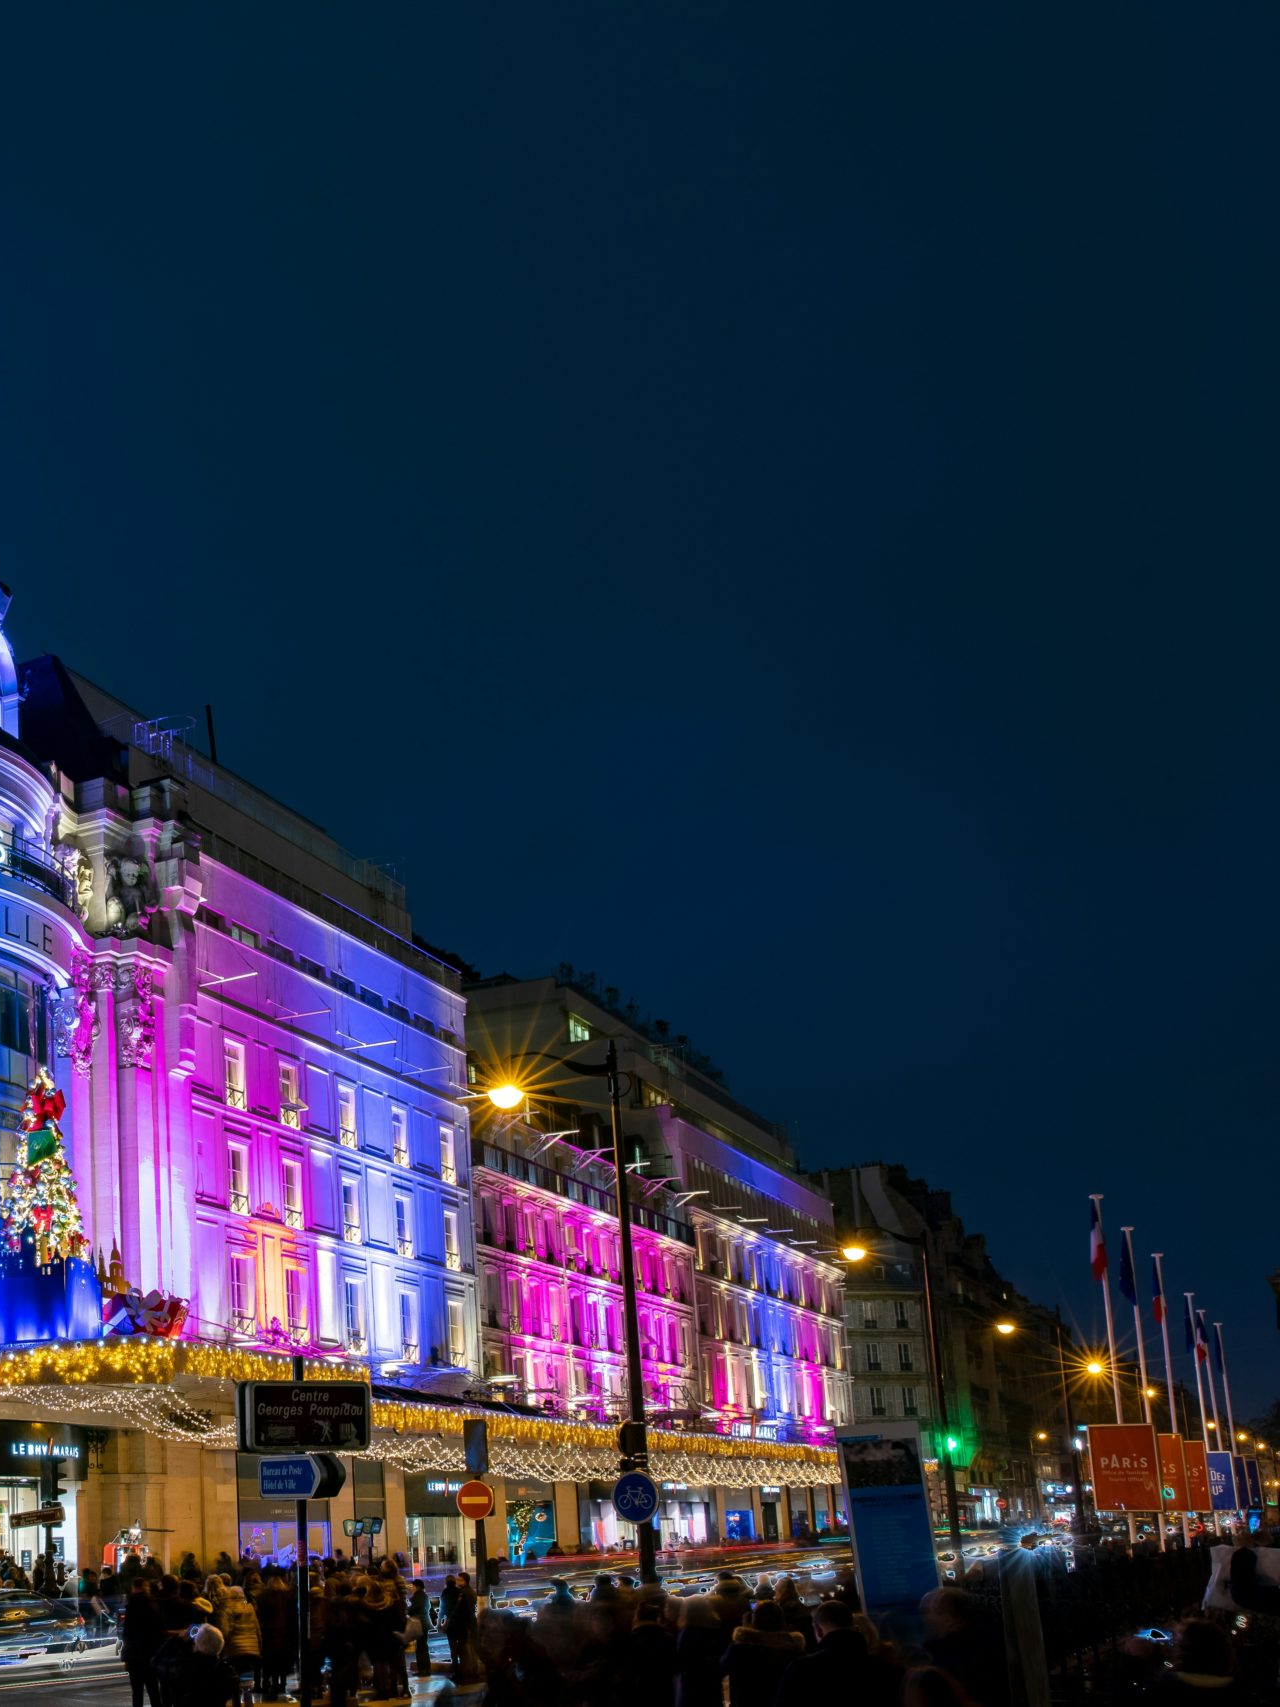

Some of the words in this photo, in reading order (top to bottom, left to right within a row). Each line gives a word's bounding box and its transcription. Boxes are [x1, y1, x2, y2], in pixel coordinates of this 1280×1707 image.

[291, 1388, 330, 1402] Centre
[257, 1403, 303, 1419] Georges
[309, 1403, 363, 1419] Pompidou
[12, 1443, 25, 1455] LE
[28, 1444, 48, 1456] BHV
[52, 1446, 79, 1458] MARAIS
[262, 1467, 280, 1476] Bureau
[282, 1466, 288, 1475] de
[289, 1465, 303, 1475] Poste
[263, 1479, 278, 1490] Hôtel
[278, 1480, 284, 1489] de
[285, 1479, 297, 1490] Ville
